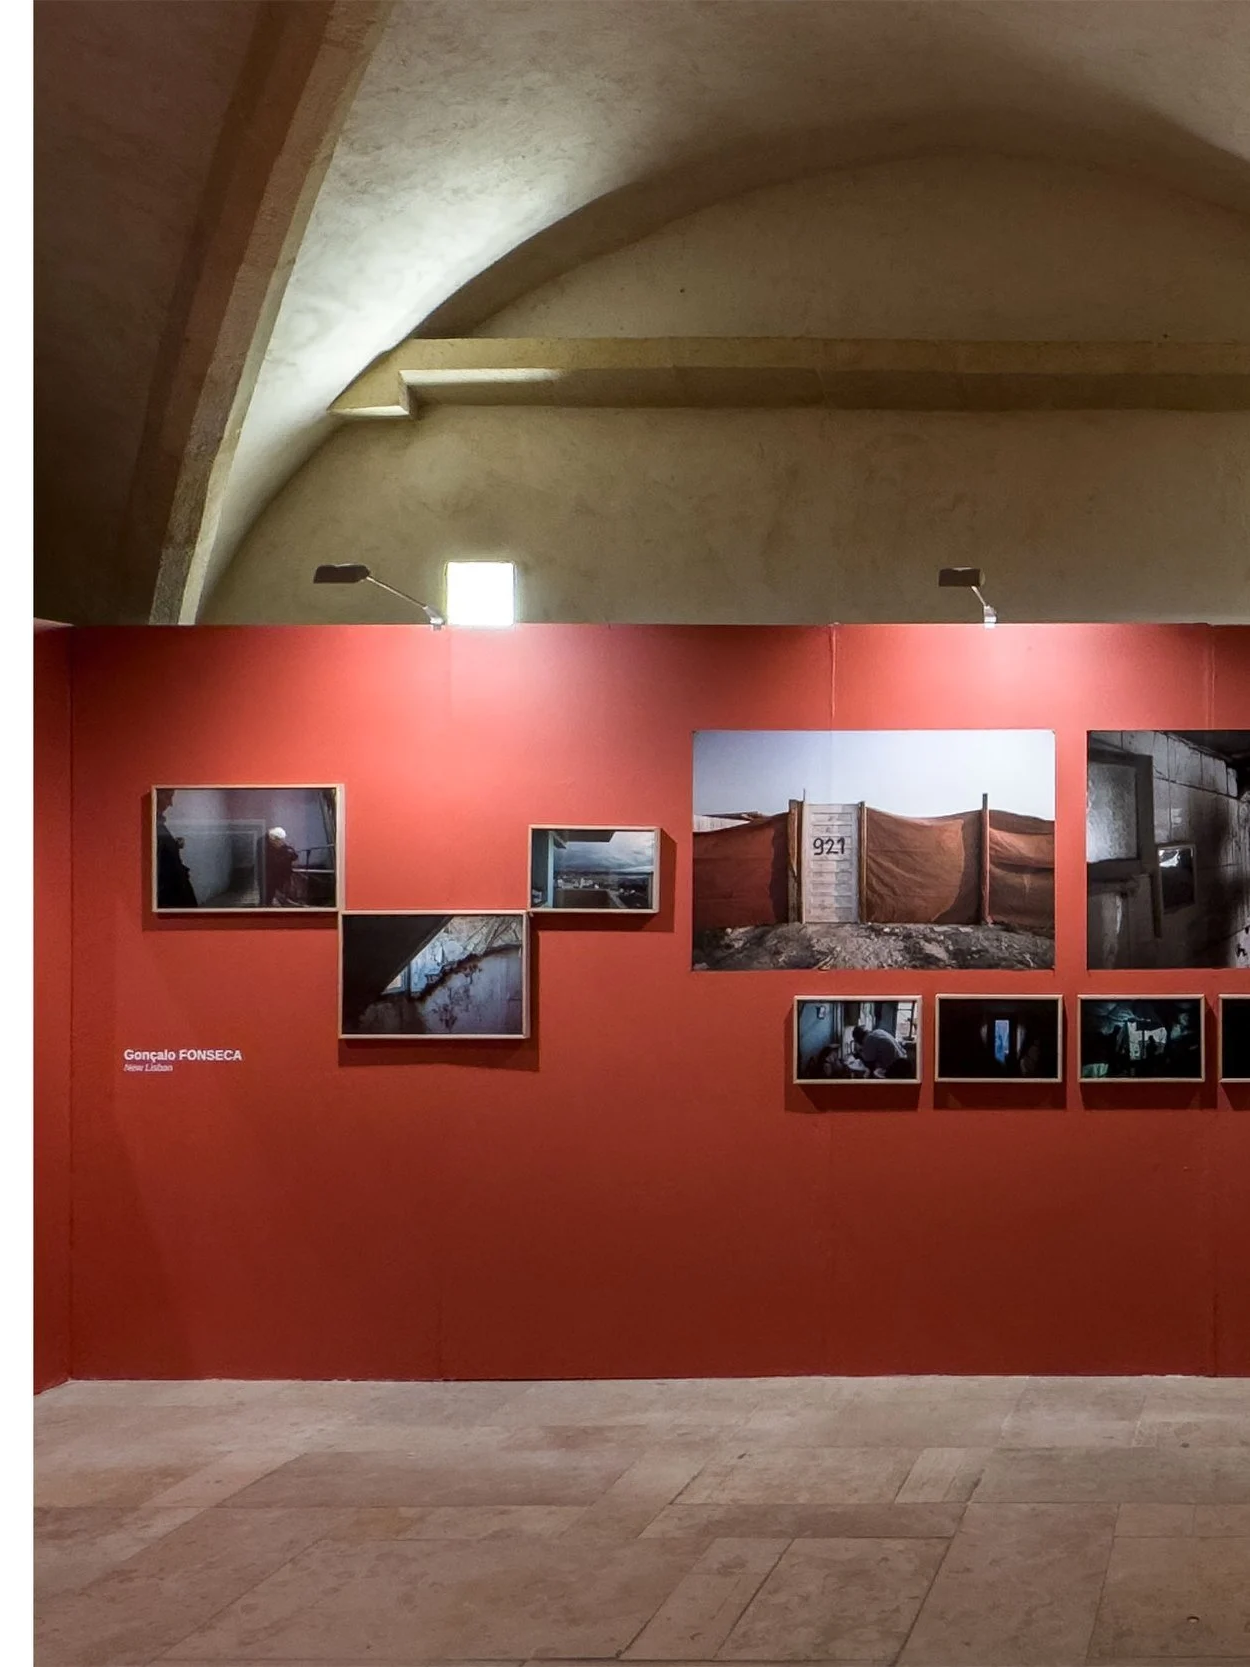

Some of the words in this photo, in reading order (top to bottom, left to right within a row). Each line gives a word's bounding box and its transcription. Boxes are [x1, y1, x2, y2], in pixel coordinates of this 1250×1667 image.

[813, 837, 846, 856] 921
[124, 1049, 176, 1062] Gonçalo
[179, 1049, 242, 1061] FONSECA
